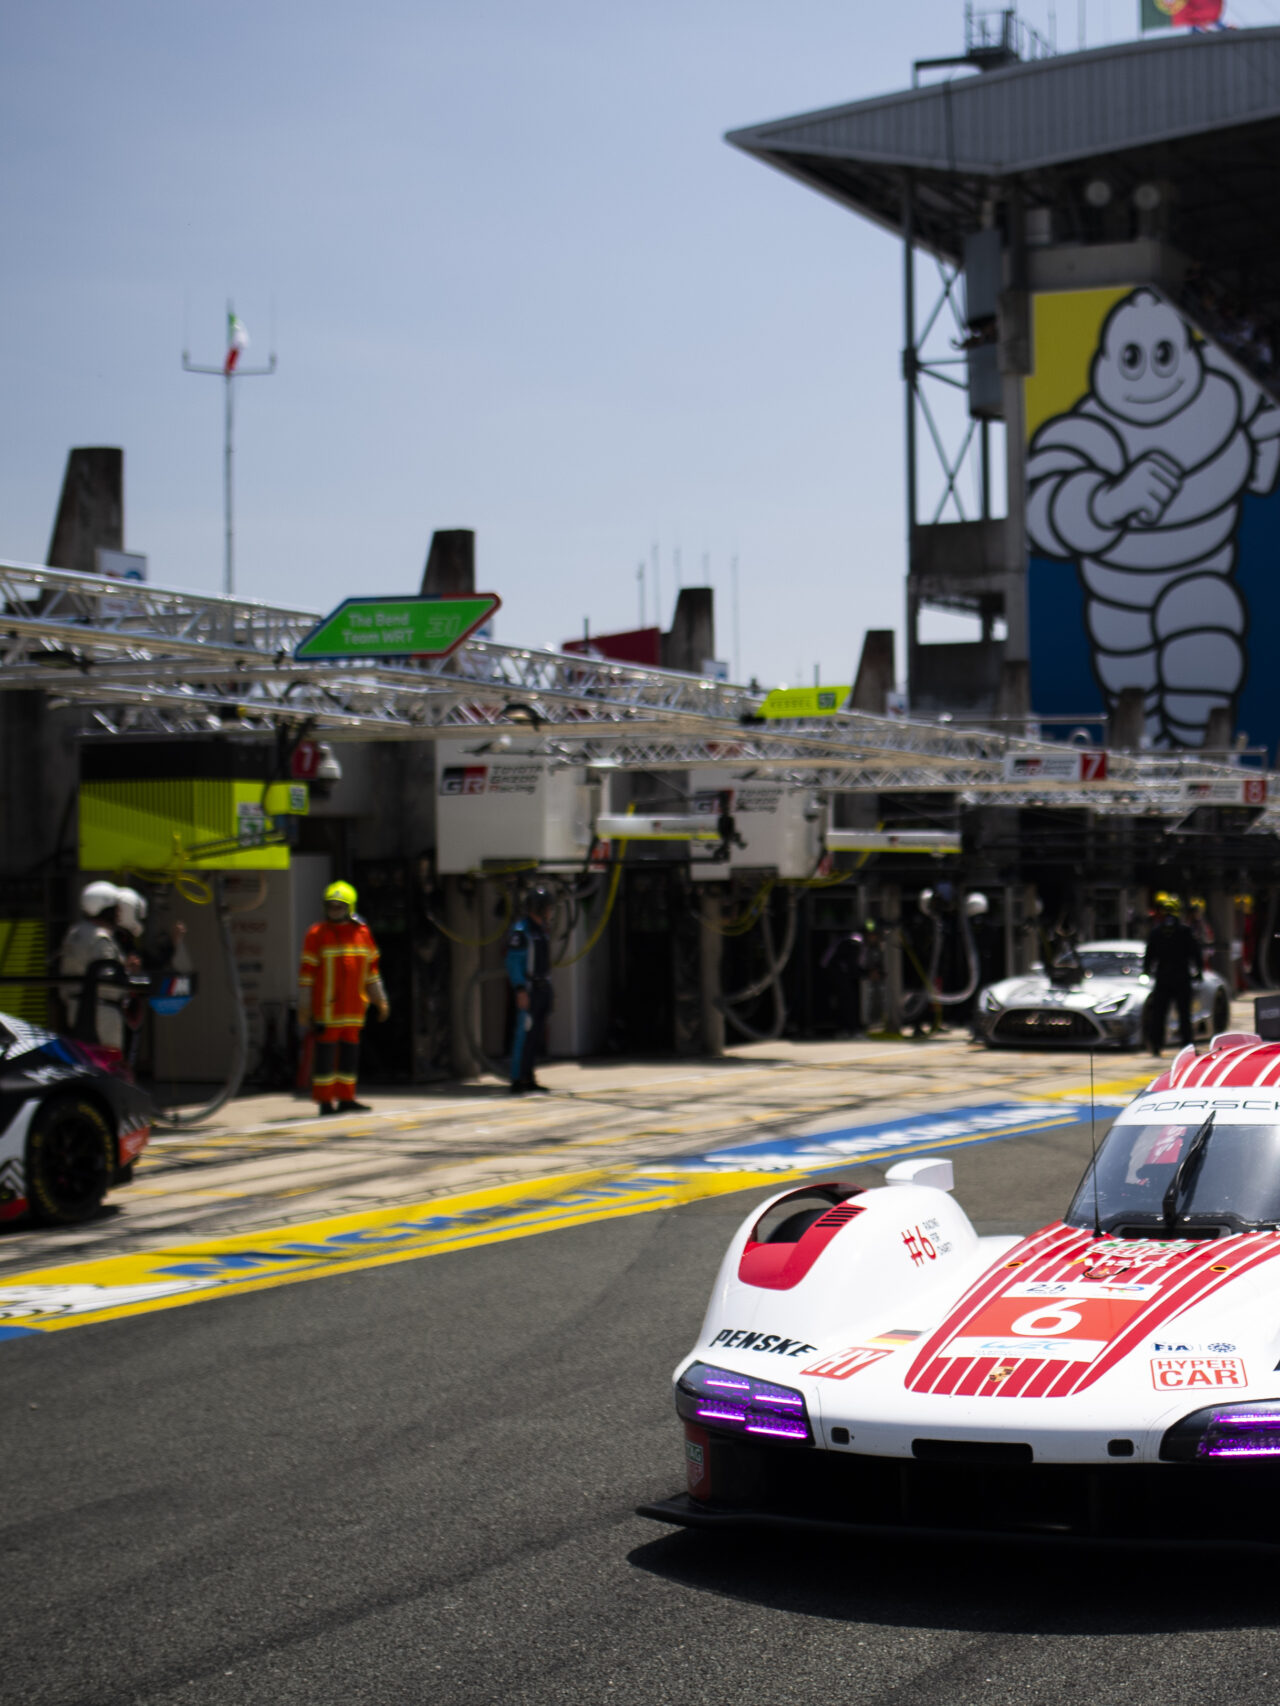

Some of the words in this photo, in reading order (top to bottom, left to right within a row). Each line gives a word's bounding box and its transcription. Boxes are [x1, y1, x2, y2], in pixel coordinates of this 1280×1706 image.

[349, 612, 373, 627] The
[375, 612, 410, 627] Bend
[341, 630, 380, 645] Team
[382, 629, 414, 644] WRT
[493, 765, 542, 774] TOYOTA
[1085, 755, 1103, 779] 7
[443, 779, 483, 794] GR
[490, 775, 538, 784] GAZOO
[489, 784, 536, 796] Racing
[901, 1225, 937, 1267] #6
[1068, 1257, 1171, 1268] Ansys
[1011, 1299, 1089, 1336] 6
[708, 1329, 819, 1357] PENSKE
[1158, 1359, 1237, 1370] HYPER
[1160, 1370, 1234, 1387] CAR
